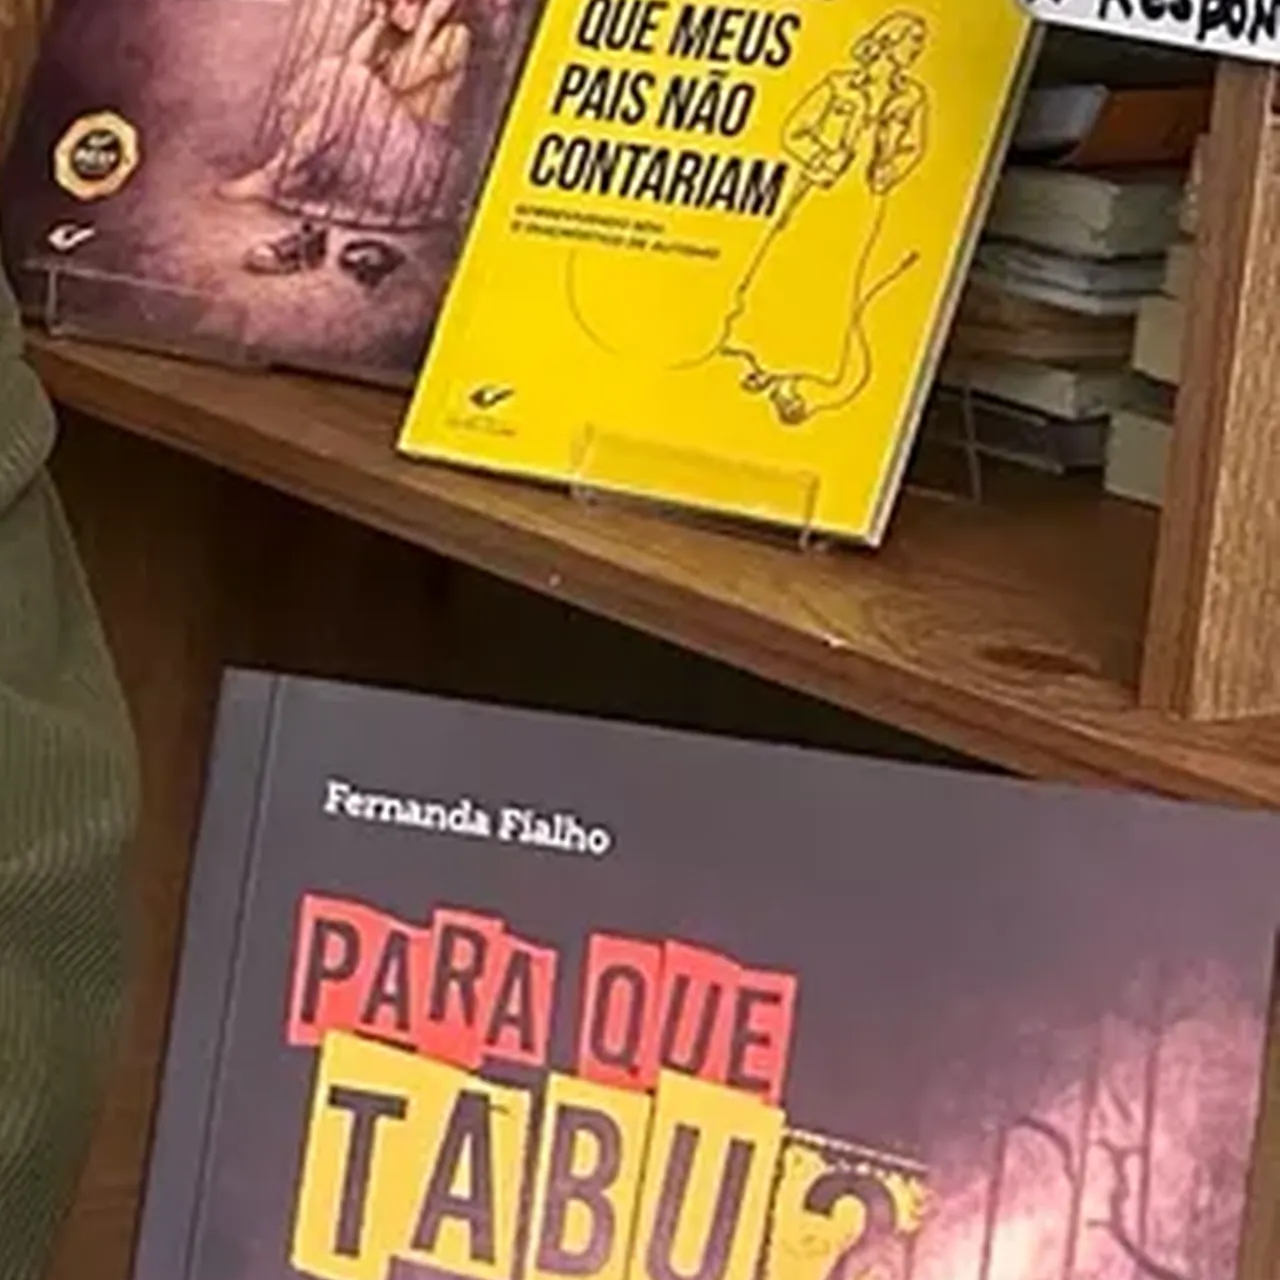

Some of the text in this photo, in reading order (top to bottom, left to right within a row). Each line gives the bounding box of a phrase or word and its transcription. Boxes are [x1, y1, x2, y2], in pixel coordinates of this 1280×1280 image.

[667, 3, 800, 70] MEUS
[551, 62, 755, 139] PAIS NÃO
[528, 131, 790, 219] CONTARIAM
[323, 781, 612, 858] Fernanda Fialho
[298, 916, 784, 1096] PARA QUE
